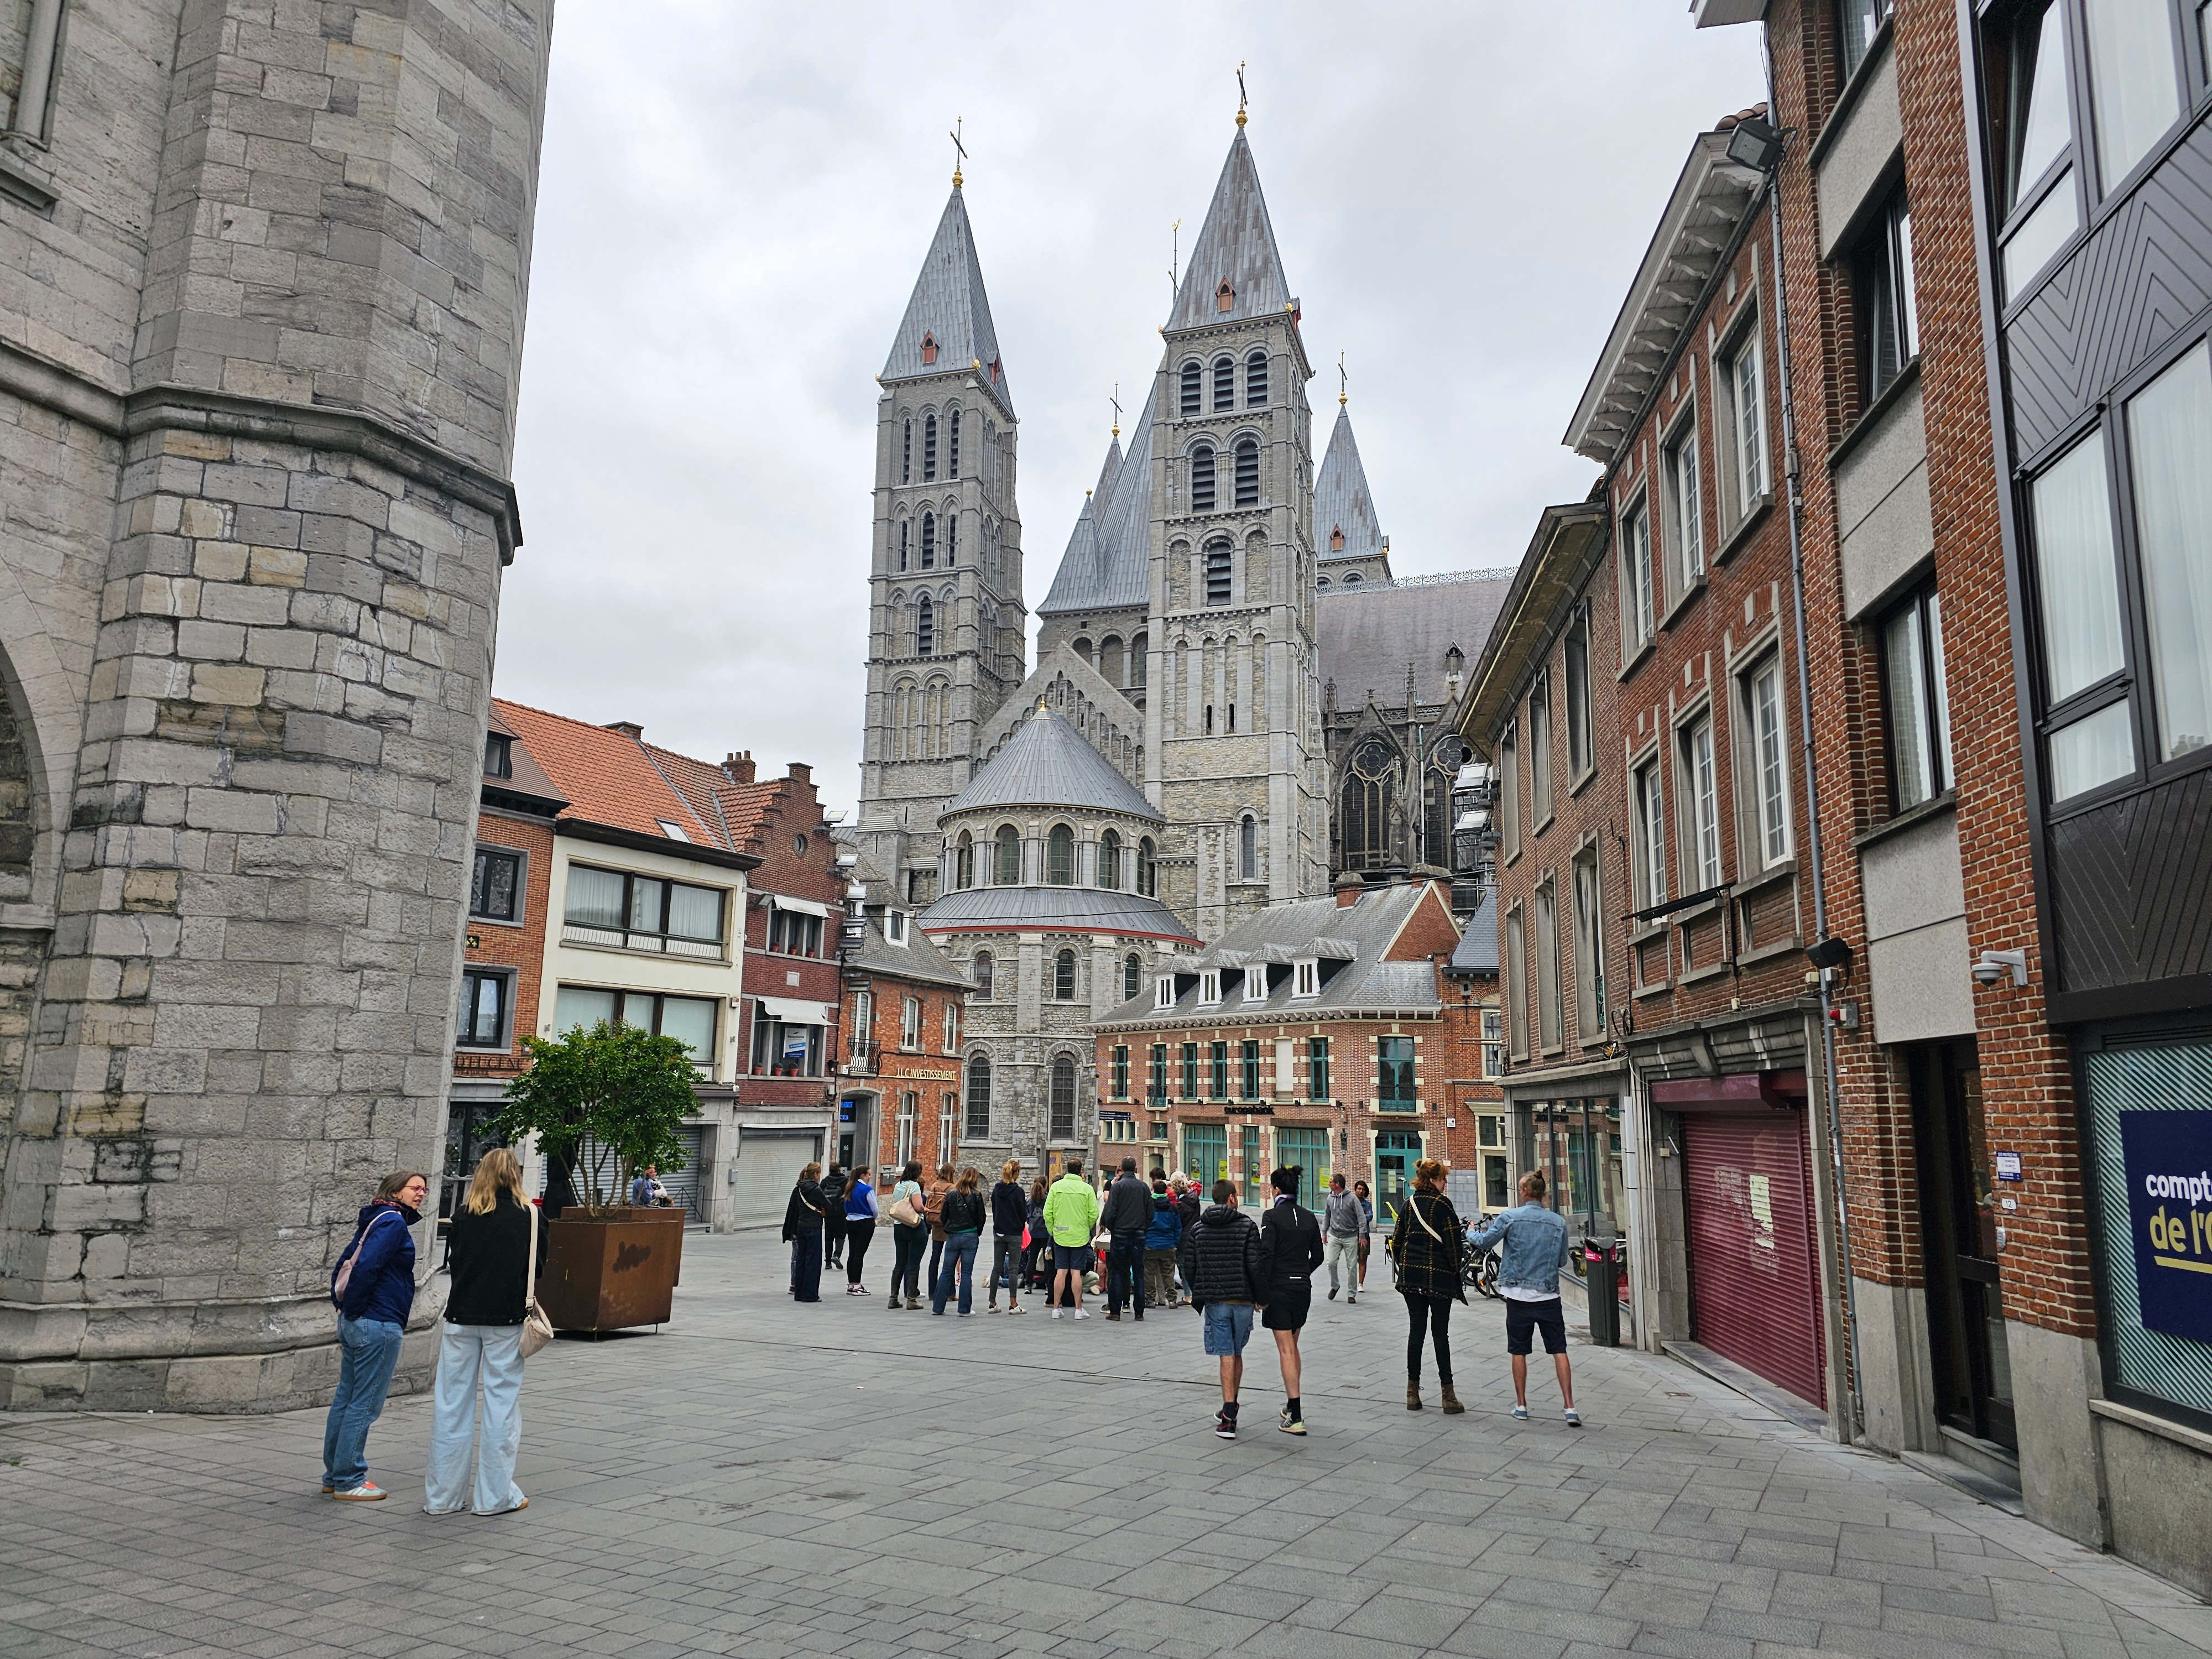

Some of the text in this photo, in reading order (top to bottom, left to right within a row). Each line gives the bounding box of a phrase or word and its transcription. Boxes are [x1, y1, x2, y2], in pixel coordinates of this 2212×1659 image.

[910, 1068, 956, 1080] INVESTISSEMENT
[2146, 1171, 2212, 1206] compt
[2005, 1200, 2012, 1208] 12
[2150, 1205, 2186, 1252] de
